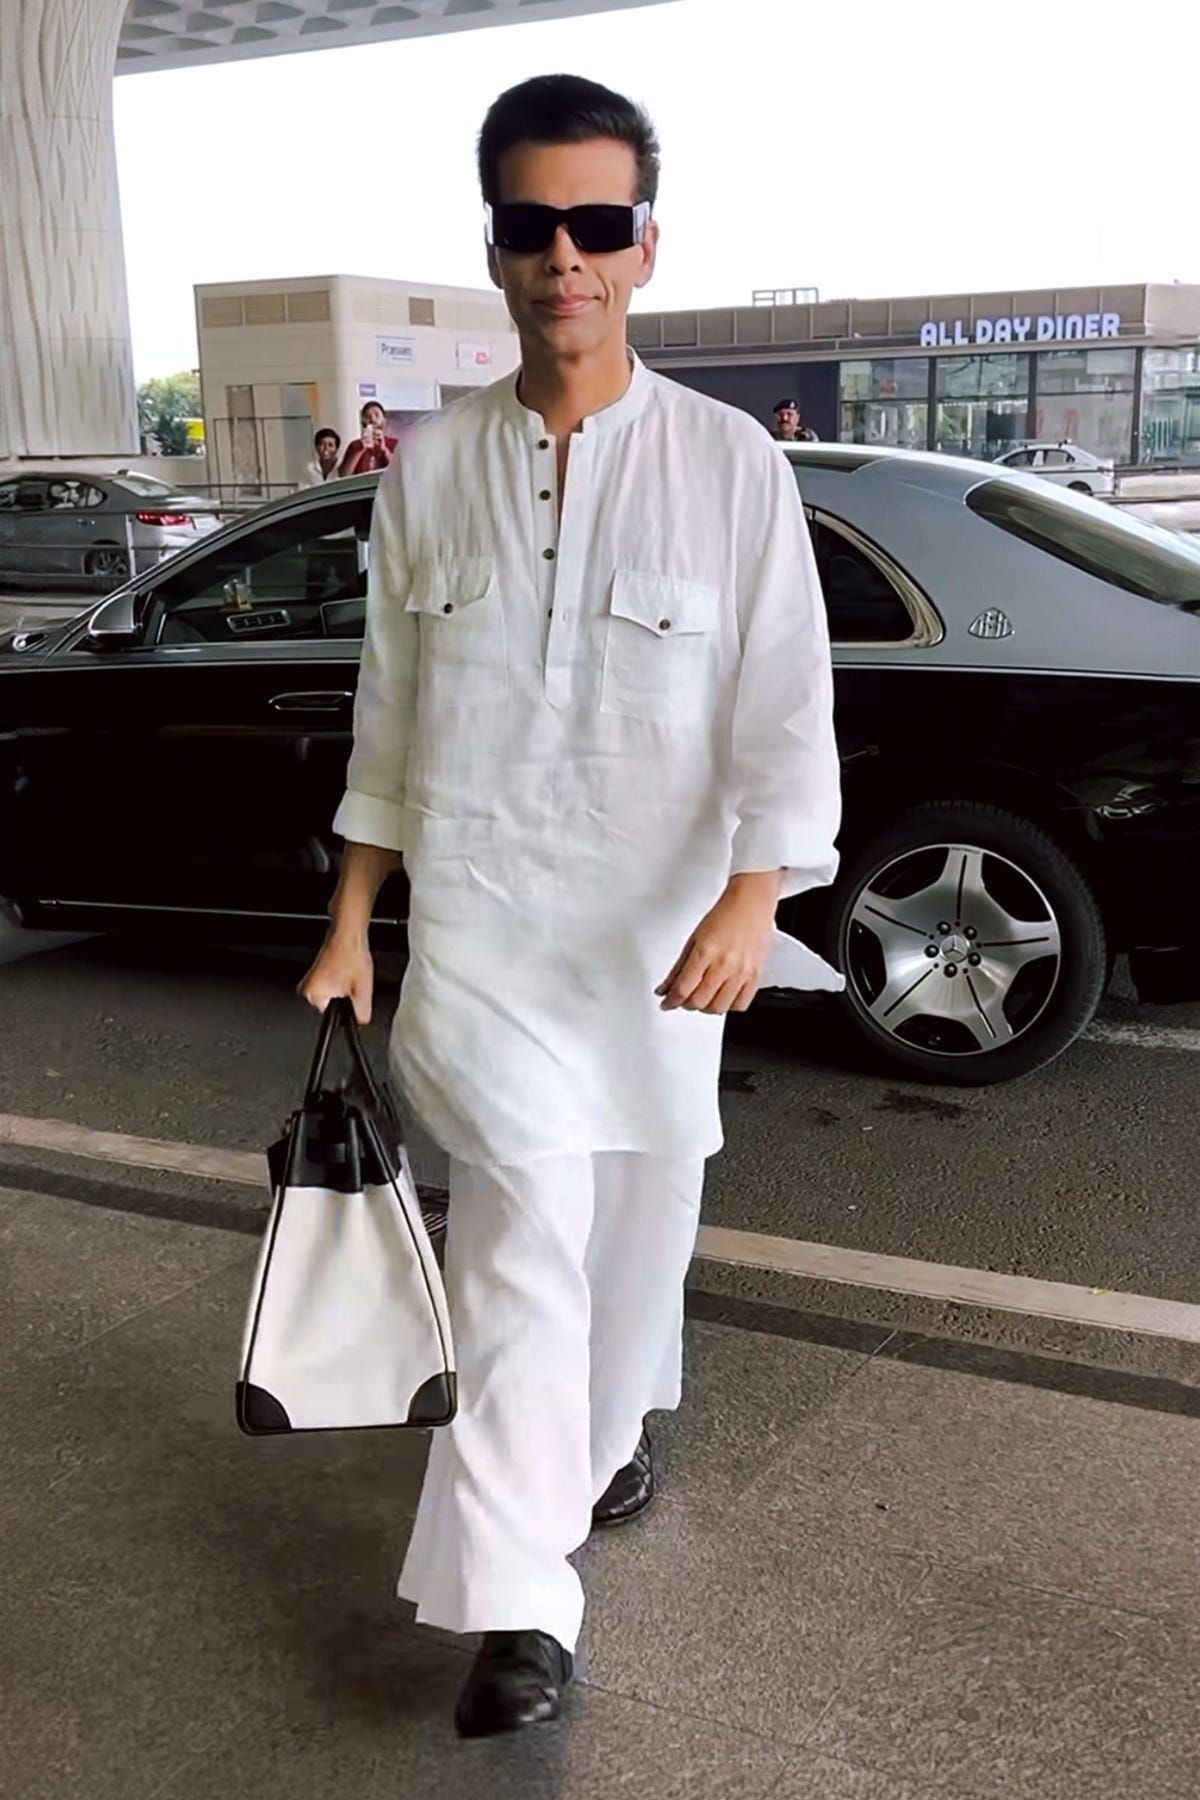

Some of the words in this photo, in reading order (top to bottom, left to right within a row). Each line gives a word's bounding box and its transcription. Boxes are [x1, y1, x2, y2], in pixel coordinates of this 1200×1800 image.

[920, 320, 968, 346] ALL
[976, 316, 1031, 344] DAY
[1037, 312, 1121, 341] DINER
